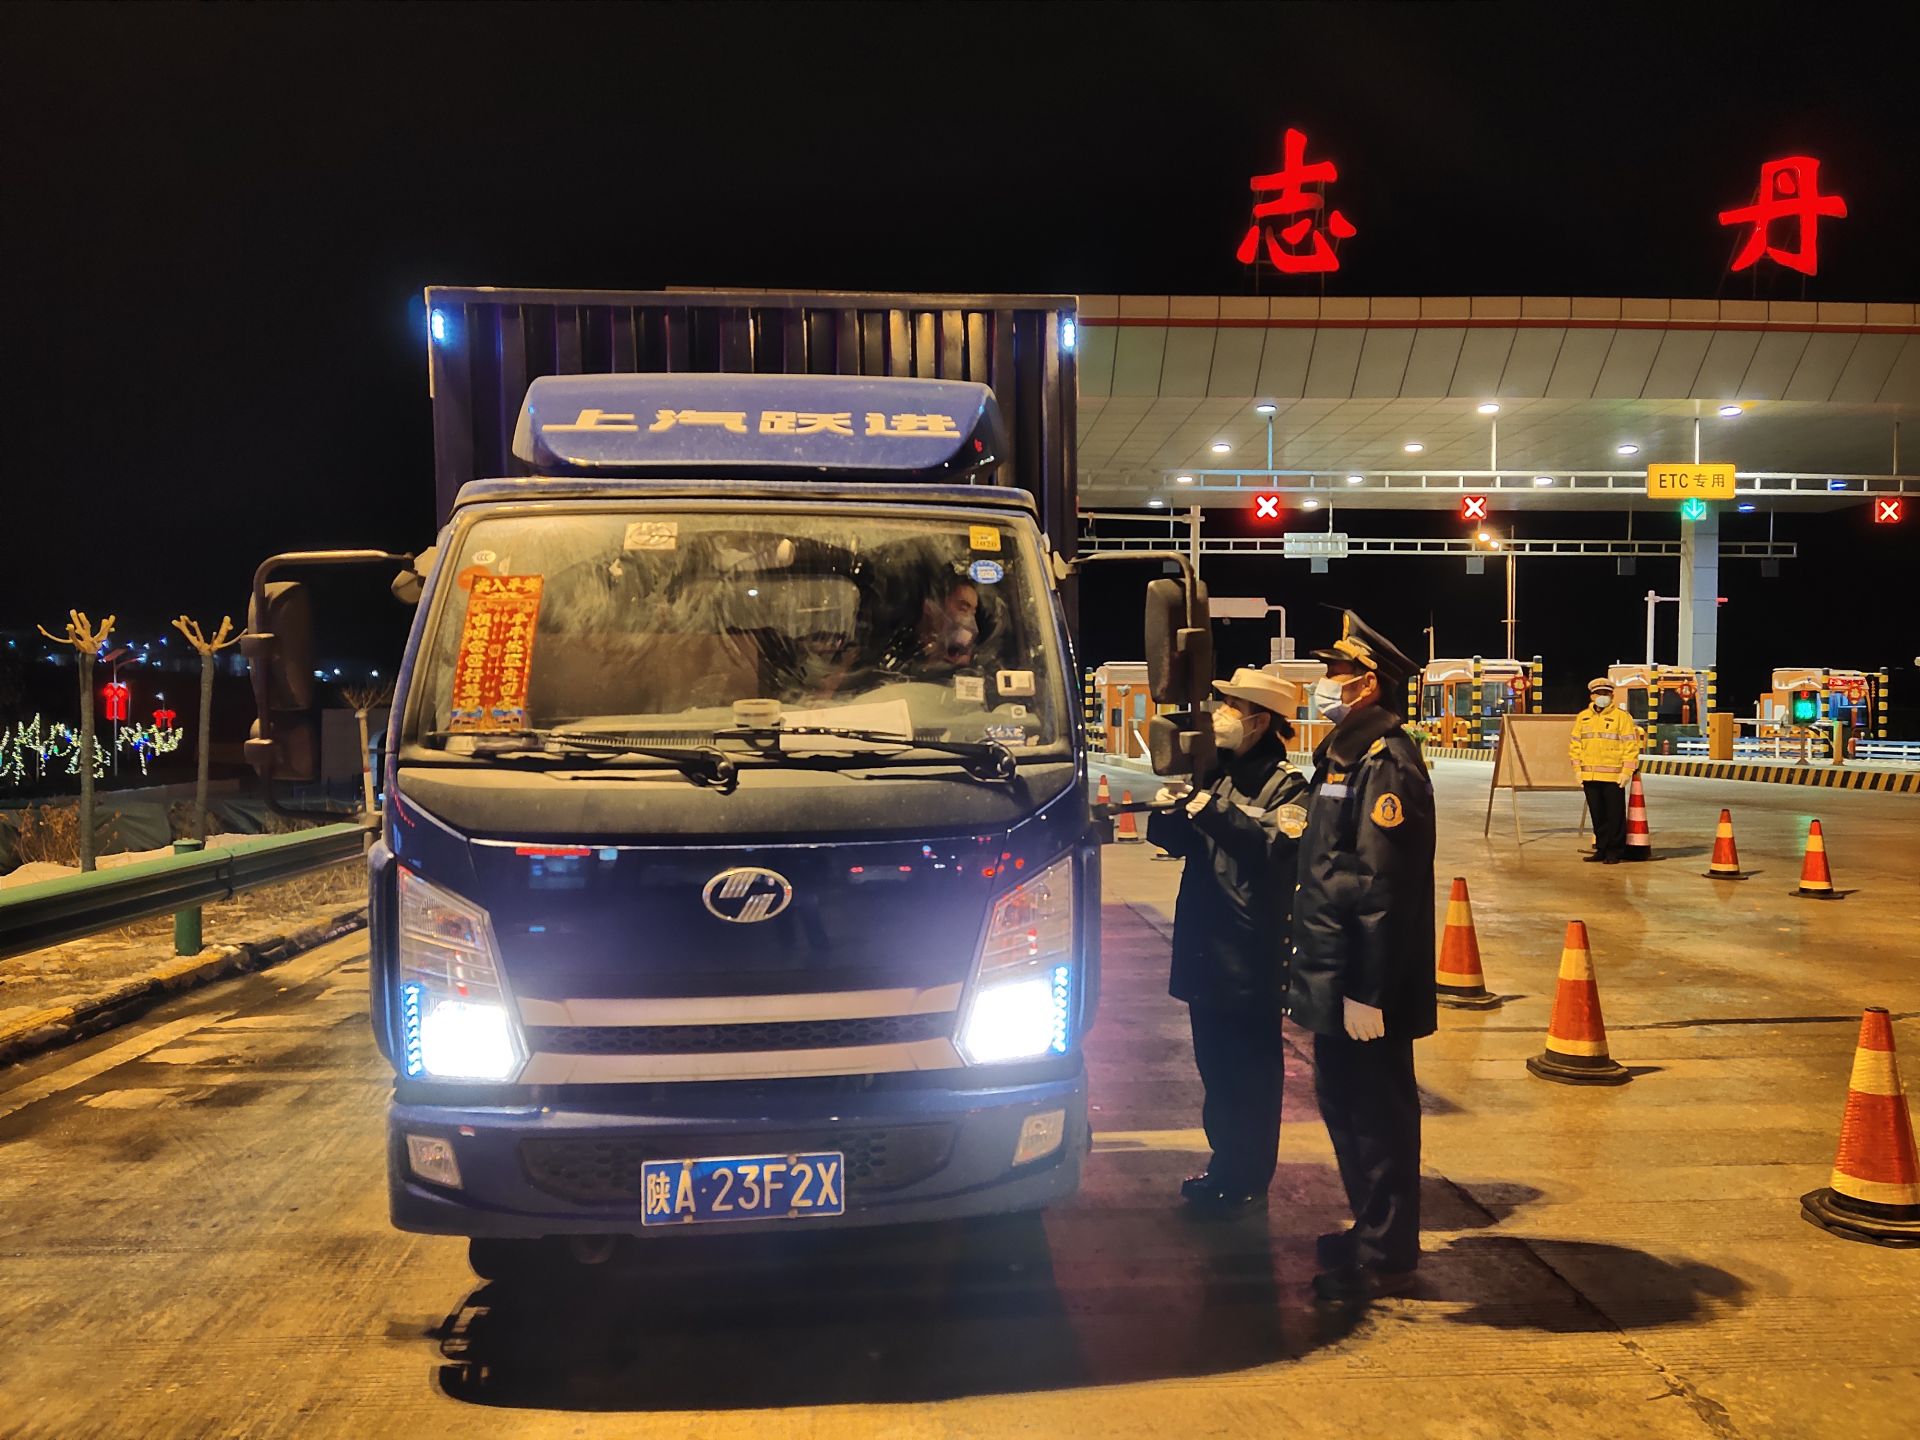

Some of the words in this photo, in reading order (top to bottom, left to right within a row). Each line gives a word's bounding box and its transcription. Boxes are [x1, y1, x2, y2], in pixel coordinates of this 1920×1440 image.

[542, 408, 961, 438] 上汽跃进
[1659, 473, 1688, 489] ETC
[1693, 473, 1725, 488] 专用
